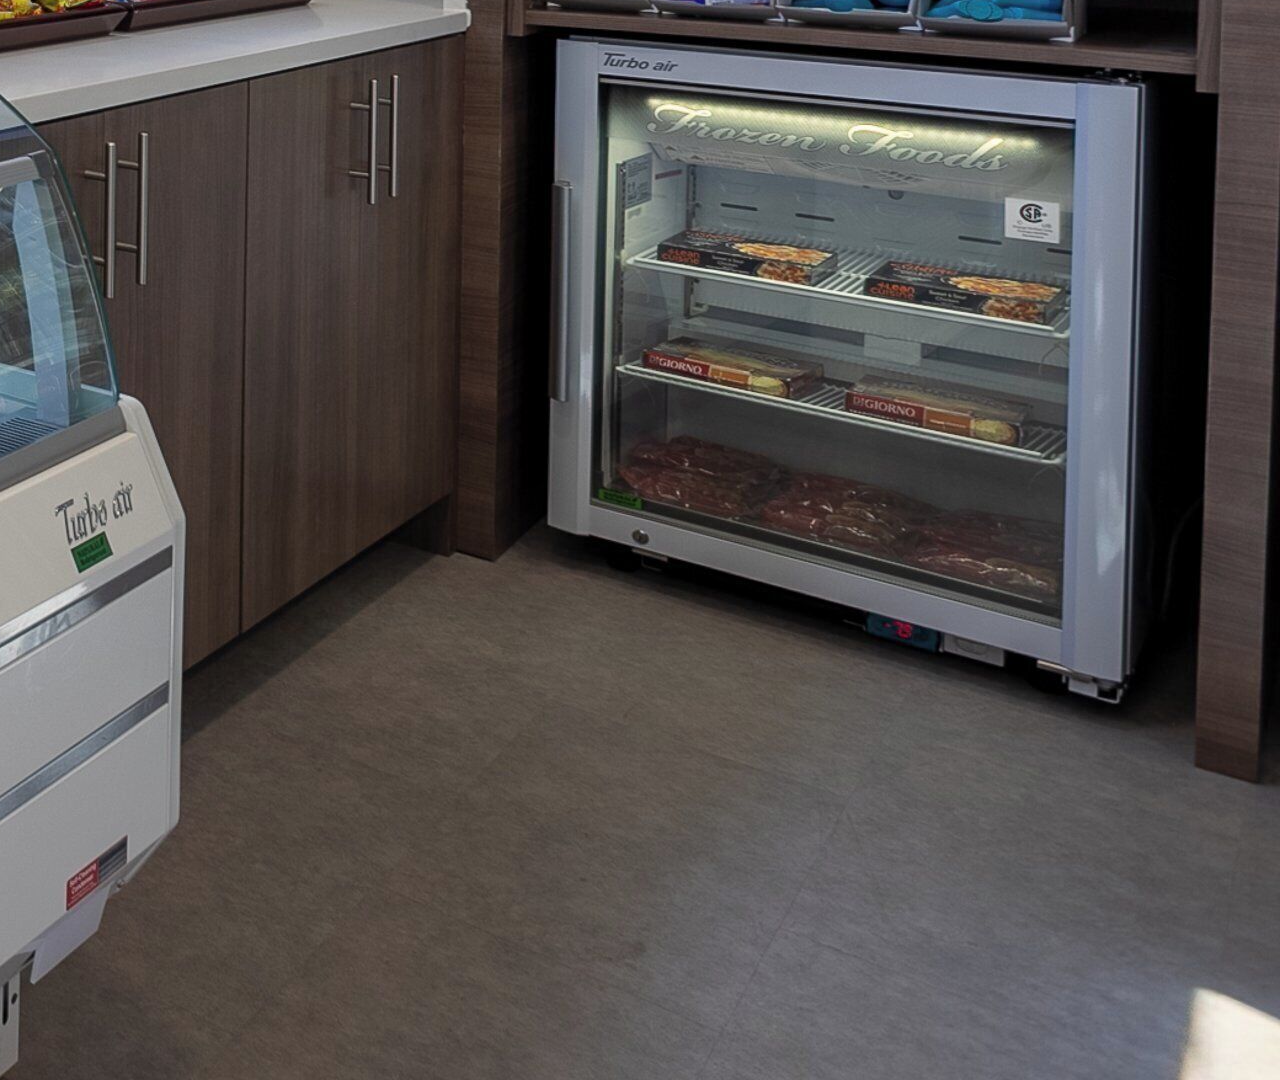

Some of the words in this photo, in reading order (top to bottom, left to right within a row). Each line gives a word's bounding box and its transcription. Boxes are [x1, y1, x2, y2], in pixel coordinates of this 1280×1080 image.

[602, 52, 650, 70] Turbo
[652, 59, 679, 73] air
[646, 103, 828, 152] Frozen
[839, 124, 1008, 171] Foods
[55, 491, 109, 546] Turbo
[112, 480, 134, 520] air
